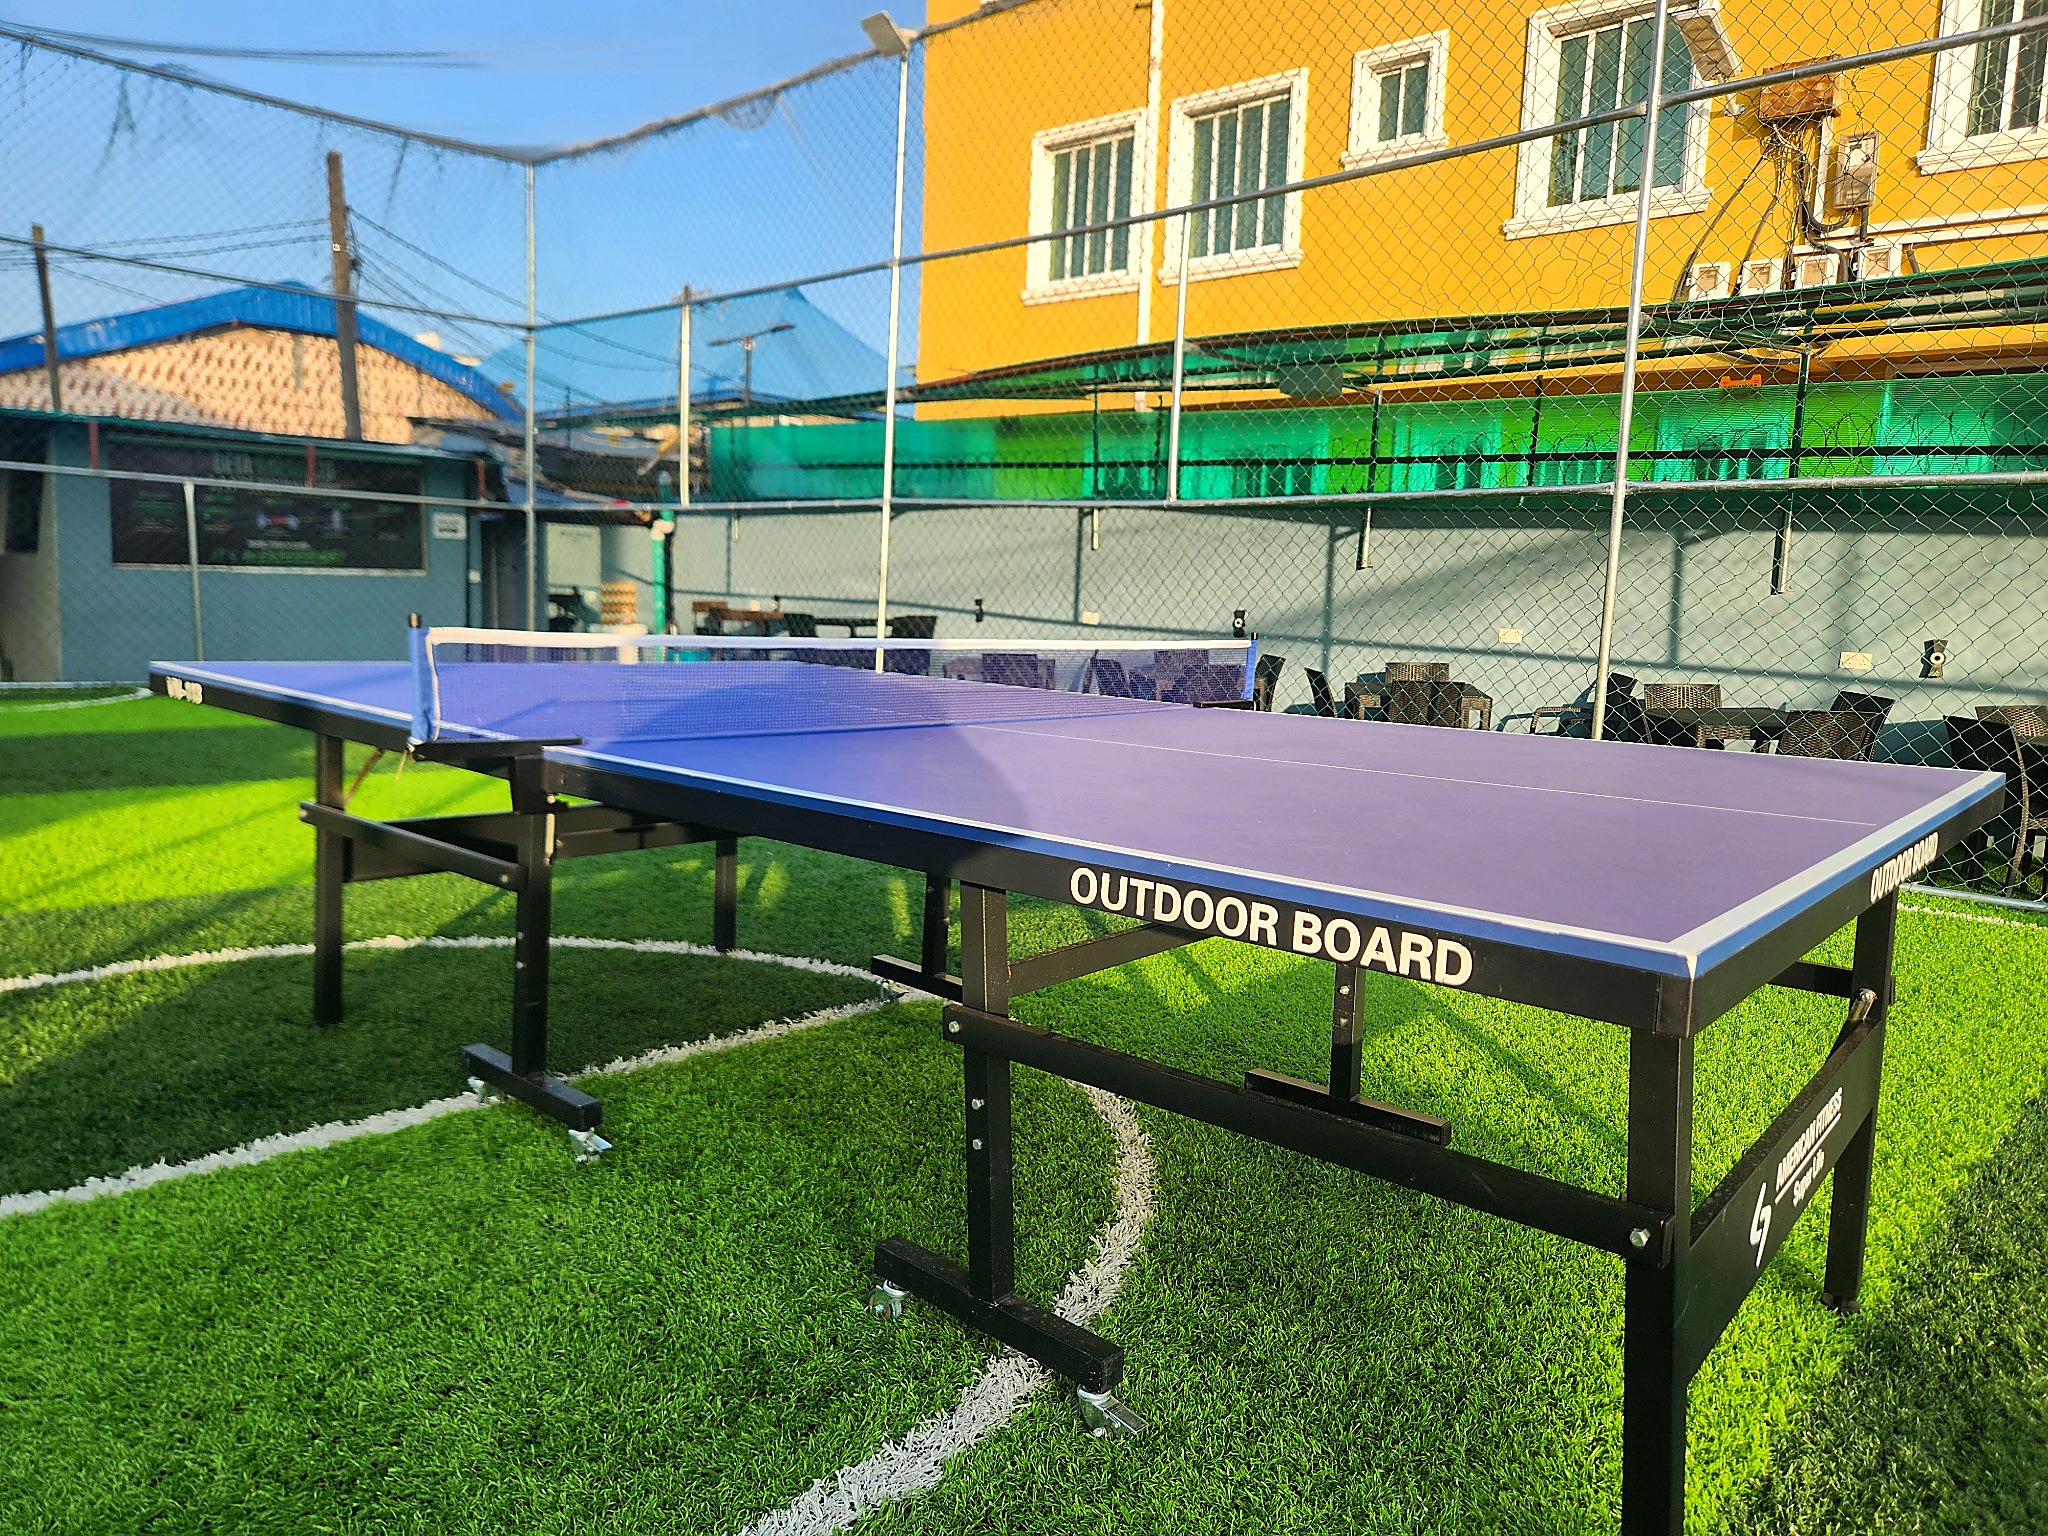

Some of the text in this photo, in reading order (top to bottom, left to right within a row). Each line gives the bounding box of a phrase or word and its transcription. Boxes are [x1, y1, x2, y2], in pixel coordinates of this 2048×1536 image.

[1870, 831, 1939, 904] OUTDOOR BOARD
[1070, 867, 1473, 986] OUTDOOR BOARD
[1775, 1086, 1843, 1192] AMERICAN FITNESS
